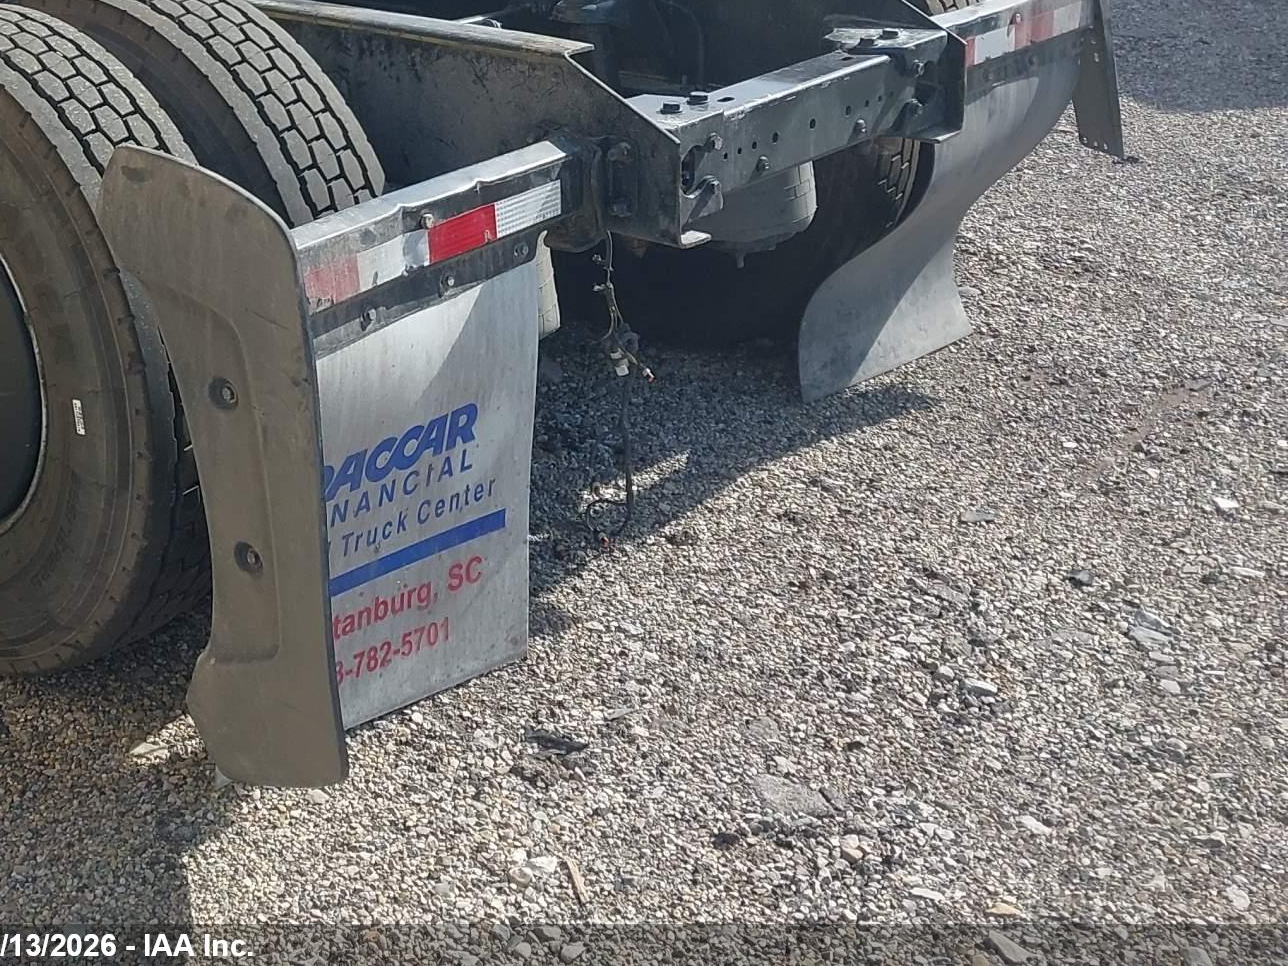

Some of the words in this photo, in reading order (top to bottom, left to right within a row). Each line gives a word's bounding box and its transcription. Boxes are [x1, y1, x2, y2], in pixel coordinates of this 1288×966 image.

[342, 509, 409, 557] Truck
[417, 478, 497, 525] Center
[447, 555, 483, 591] SC
